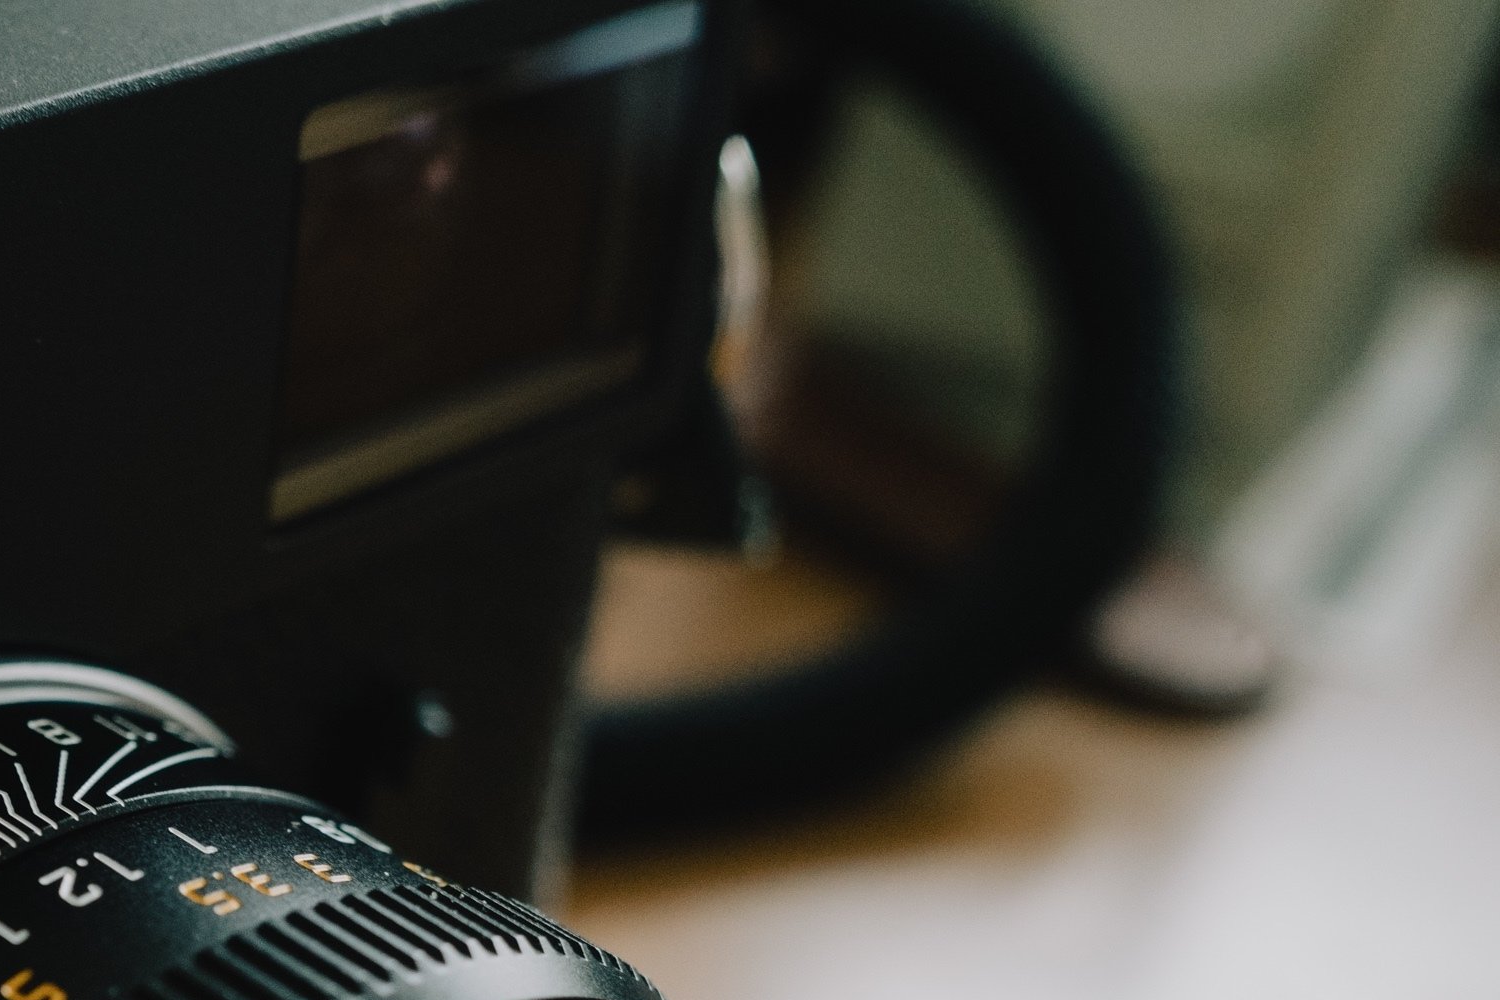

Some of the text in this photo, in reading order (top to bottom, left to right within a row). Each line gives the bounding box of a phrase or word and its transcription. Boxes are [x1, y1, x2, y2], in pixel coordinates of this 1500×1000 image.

[26, 717, 83, 746] 8
[168, 826, 219, 855] 1
[37, 851, 145, 908] 1.2
[293, 853, 353, 883] 3
[178, 862, 294, 916] 3.5
